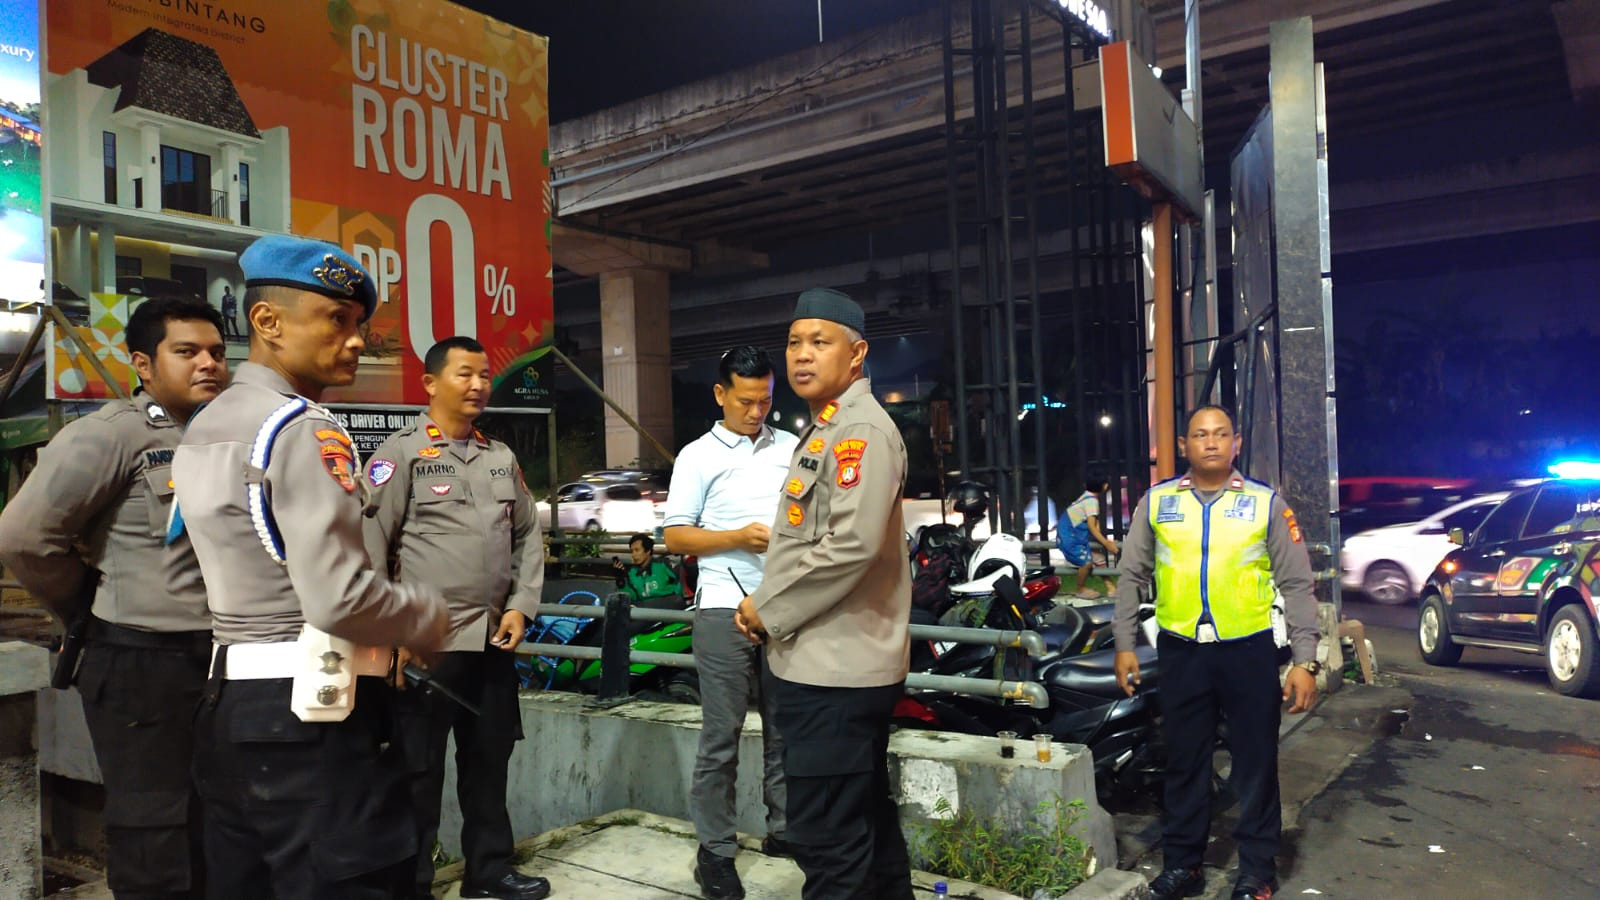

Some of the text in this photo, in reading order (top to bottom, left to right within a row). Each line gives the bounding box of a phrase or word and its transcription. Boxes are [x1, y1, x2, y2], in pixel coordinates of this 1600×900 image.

[352, 23, 509, 121] CLUSTER
[352, 83, 512, 201] ROMA
[351, 414, 385, 428] DRIVER
[387, 414, 417, 428] ONLIN
[416, 464, 456, 477] MARNO
